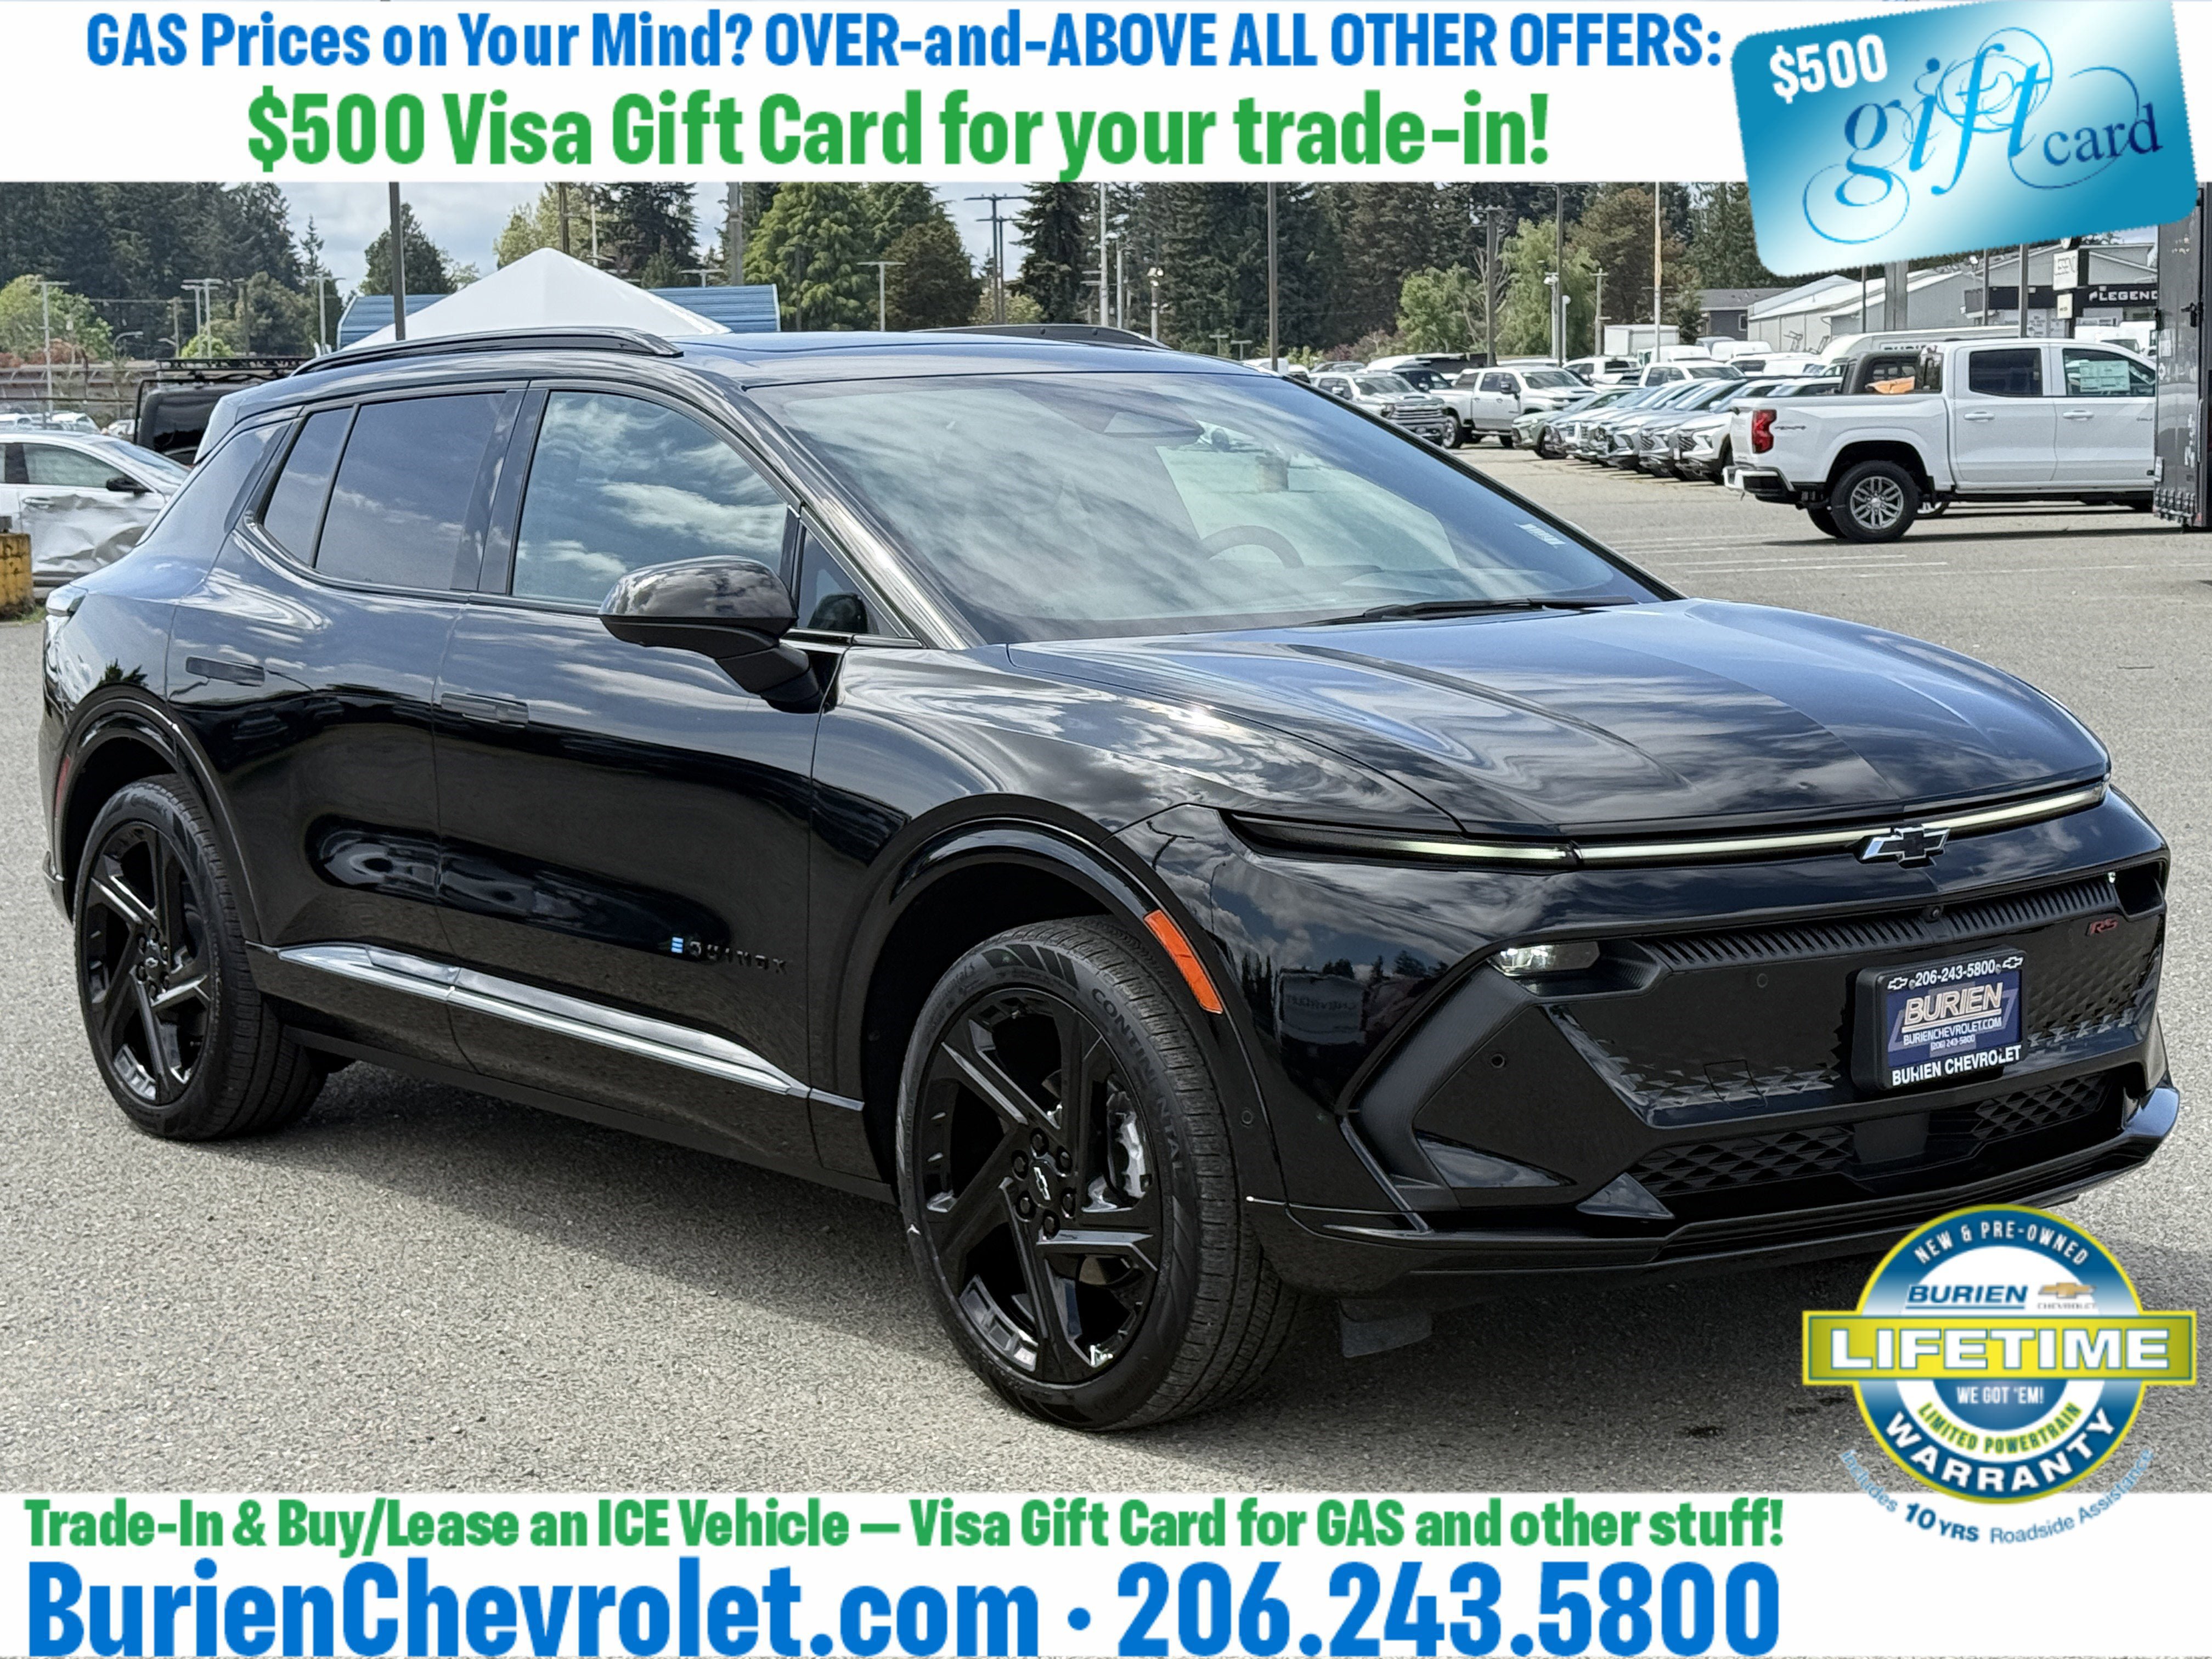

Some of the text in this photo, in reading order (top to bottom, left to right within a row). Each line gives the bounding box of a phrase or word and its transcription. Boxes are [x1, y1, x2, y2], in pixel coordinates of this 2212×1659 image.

[1914, 958, 1996, 987] 206-243-5800
[1904, 982, 2004, 1025] BURIEN
[1903, 1016, 2002, 1046] BURIENCHEVROLET.COM
[1892, 1045, 2022, 1086] BURIEN CHEVROLET
